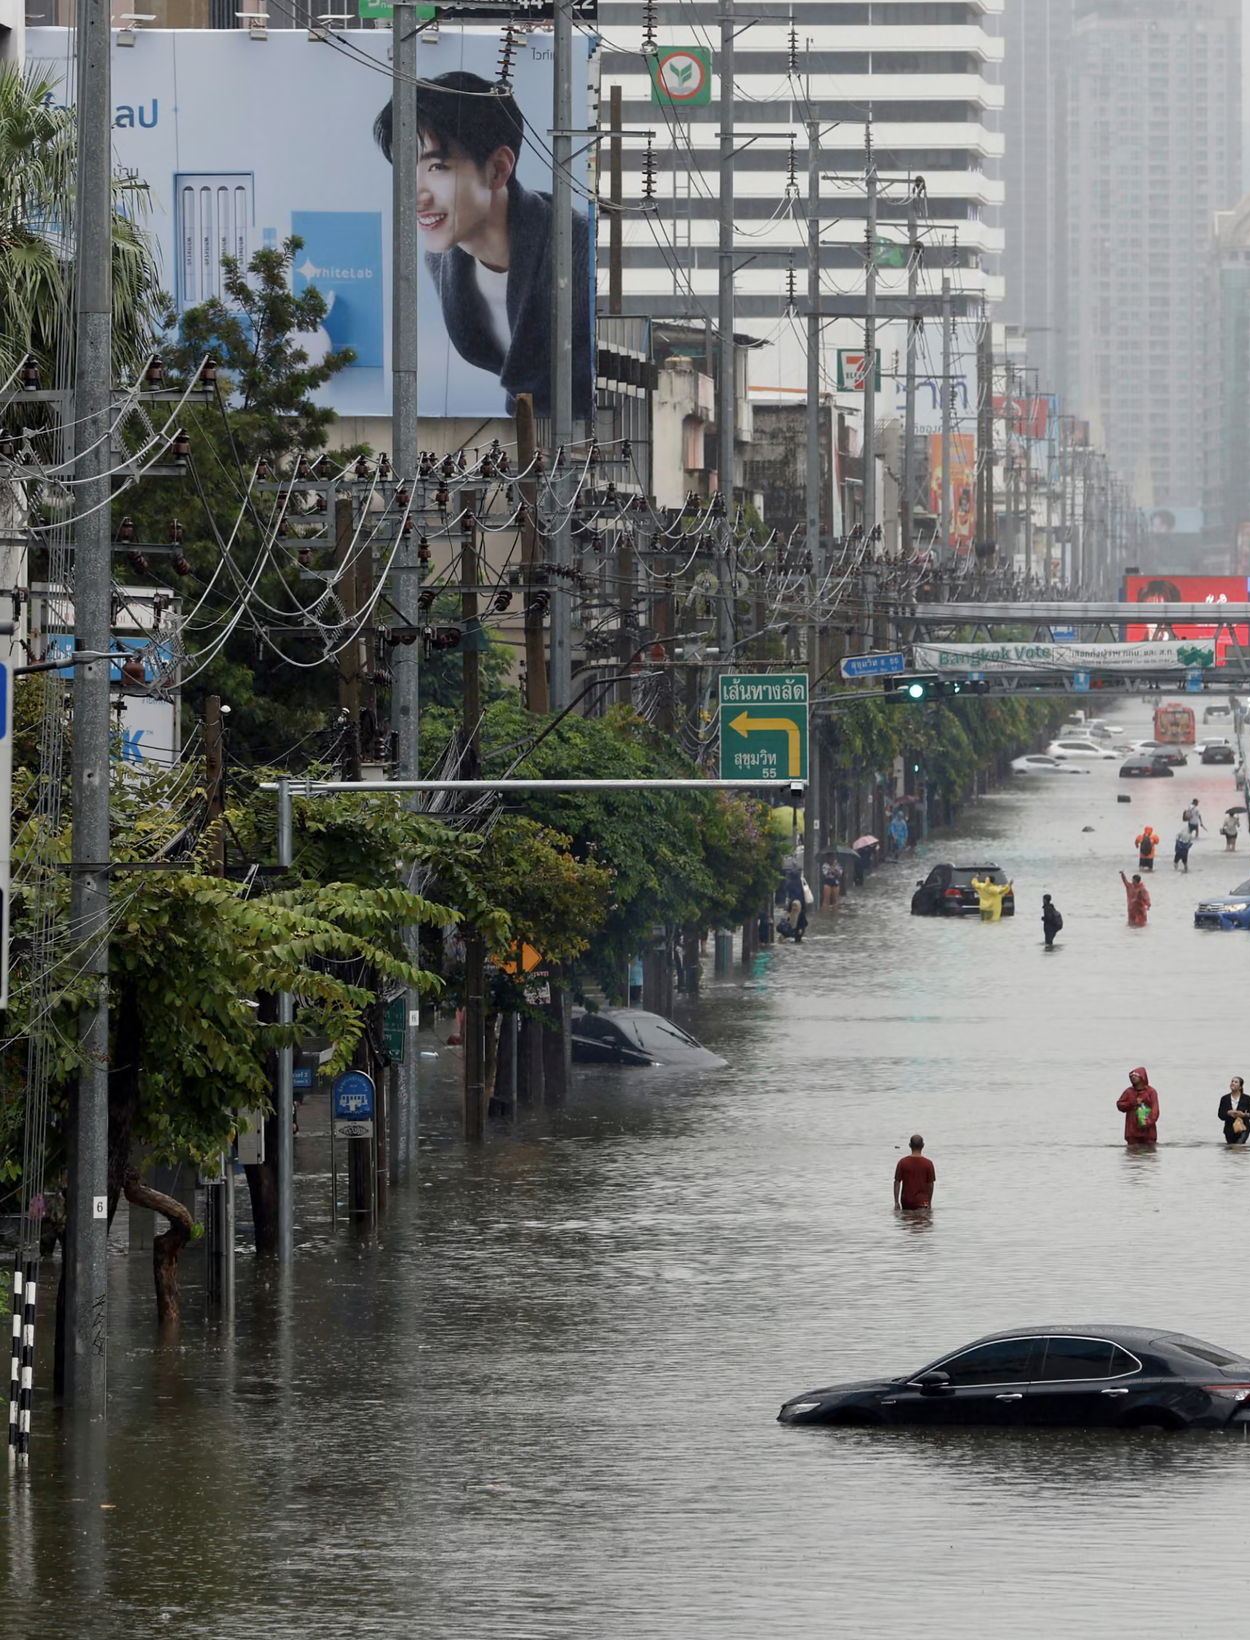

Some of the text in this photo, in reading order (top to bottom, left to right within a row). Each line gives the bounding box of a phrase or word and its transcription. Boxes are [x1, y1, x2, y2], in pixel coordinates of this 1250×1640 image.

[939, 645, 1052, 667] Bangkok Vote
[723, 678, 805, 701] เส้นทางลัด
[734, 749, 777, 770] สุขุมวิท
[762, 768, 777, 779] 55
[96, 1201, 104, 1213] 6
